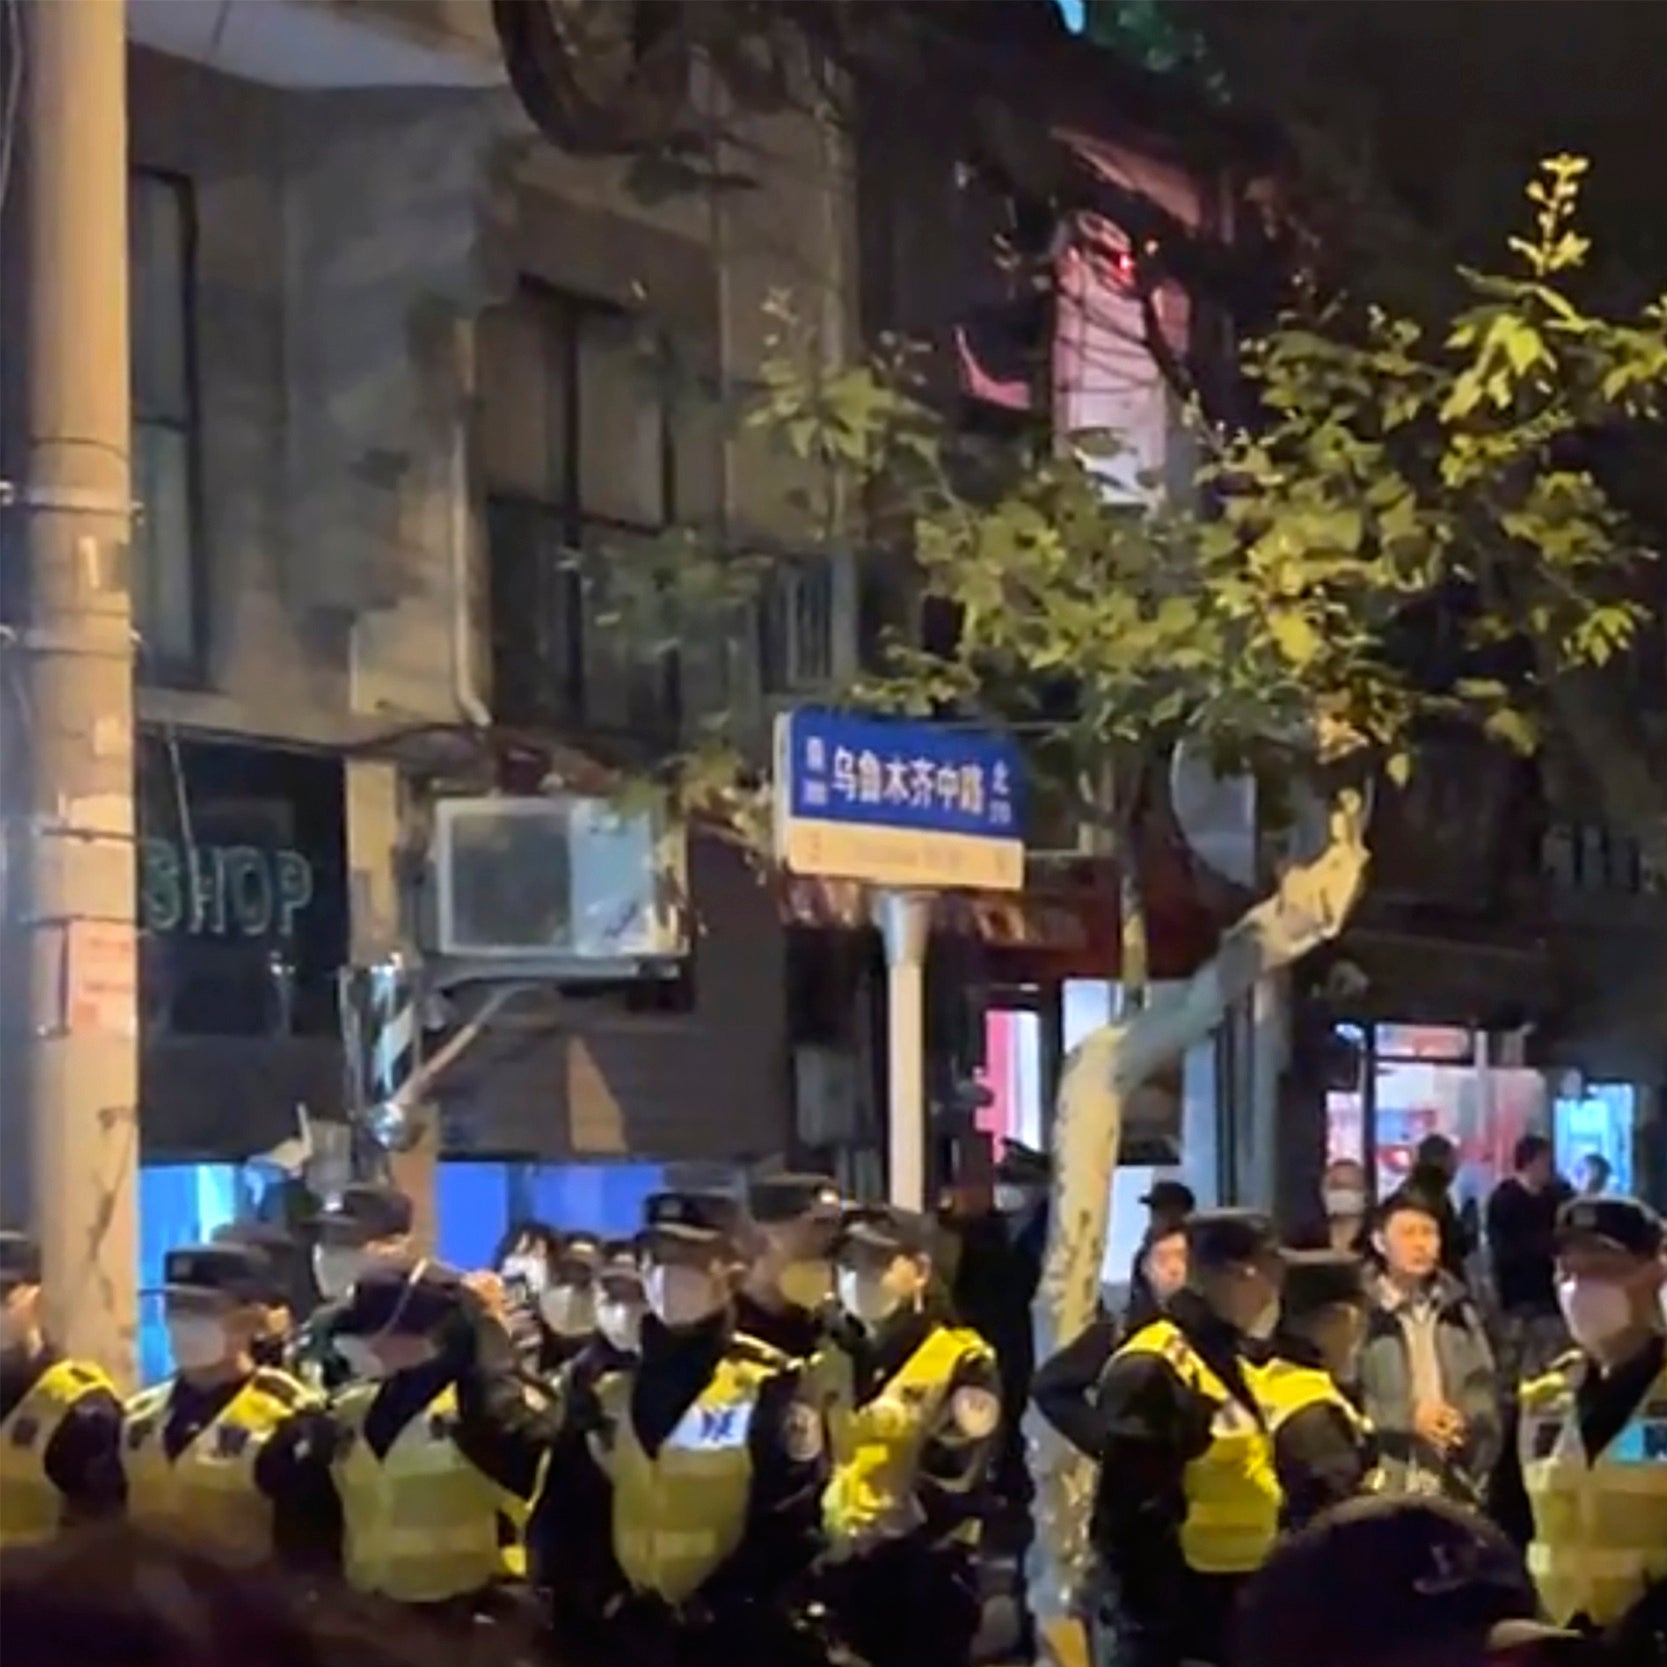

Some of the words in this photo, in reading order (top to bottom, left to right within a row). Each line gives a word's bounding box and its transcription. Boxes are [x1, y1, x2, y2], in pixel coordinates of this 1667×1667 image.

[832, 745, 984, 816] 乌鲁木齐中路
[144, 838, 314, 936] SHOP
